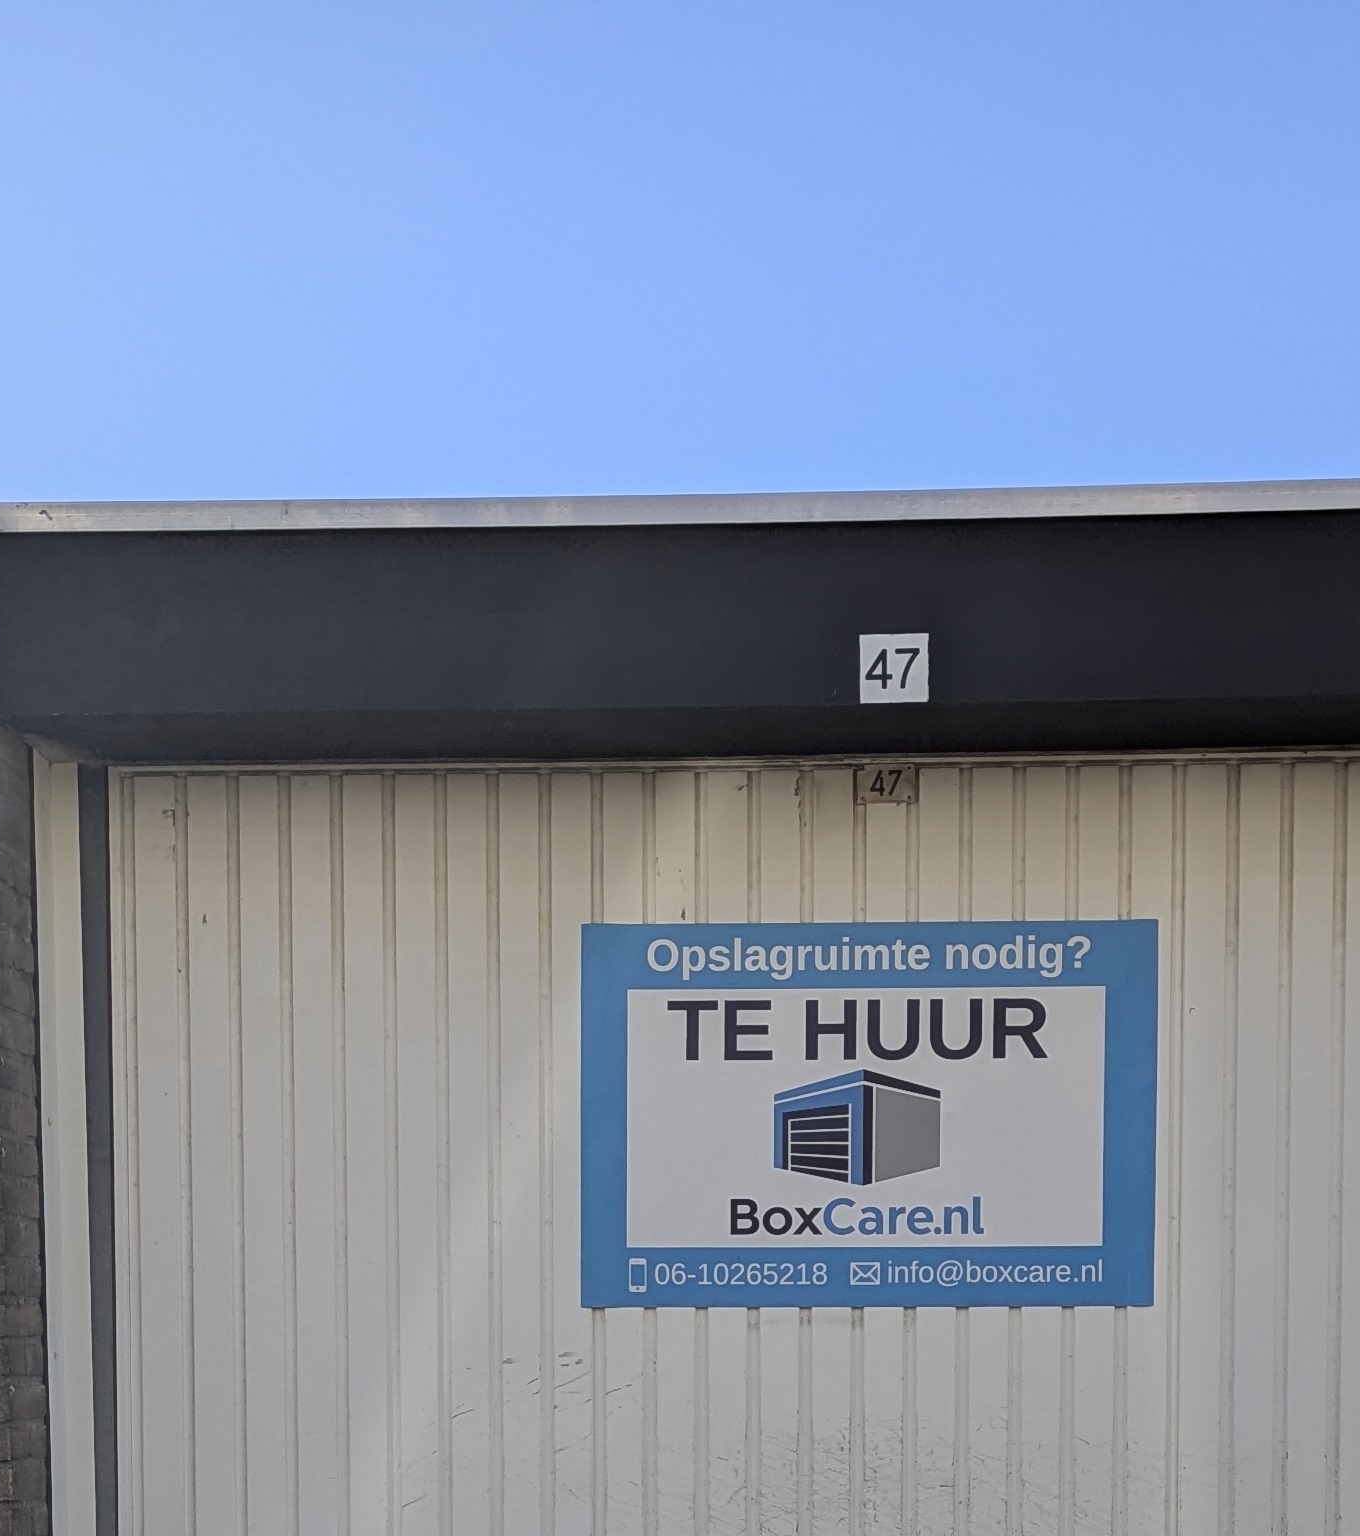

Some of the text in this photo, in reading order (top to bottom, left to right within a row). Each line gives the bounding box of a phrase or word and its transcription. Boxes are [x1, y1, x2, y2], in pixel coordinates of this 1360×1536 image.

[865, 648, 920, 689] 47
[869, 769, 903, 797] 47
[646, 935, 1092, 980] Opslagruimte nodig?
[666, 998, 1049, 1061] TE HUUR
[729, 1196, 985, 1237] BoxCare.nl
[654, 1262, 828, 1286] 06-10265218
[887, 1259, 1103, 1288] info@boxcare.nl
